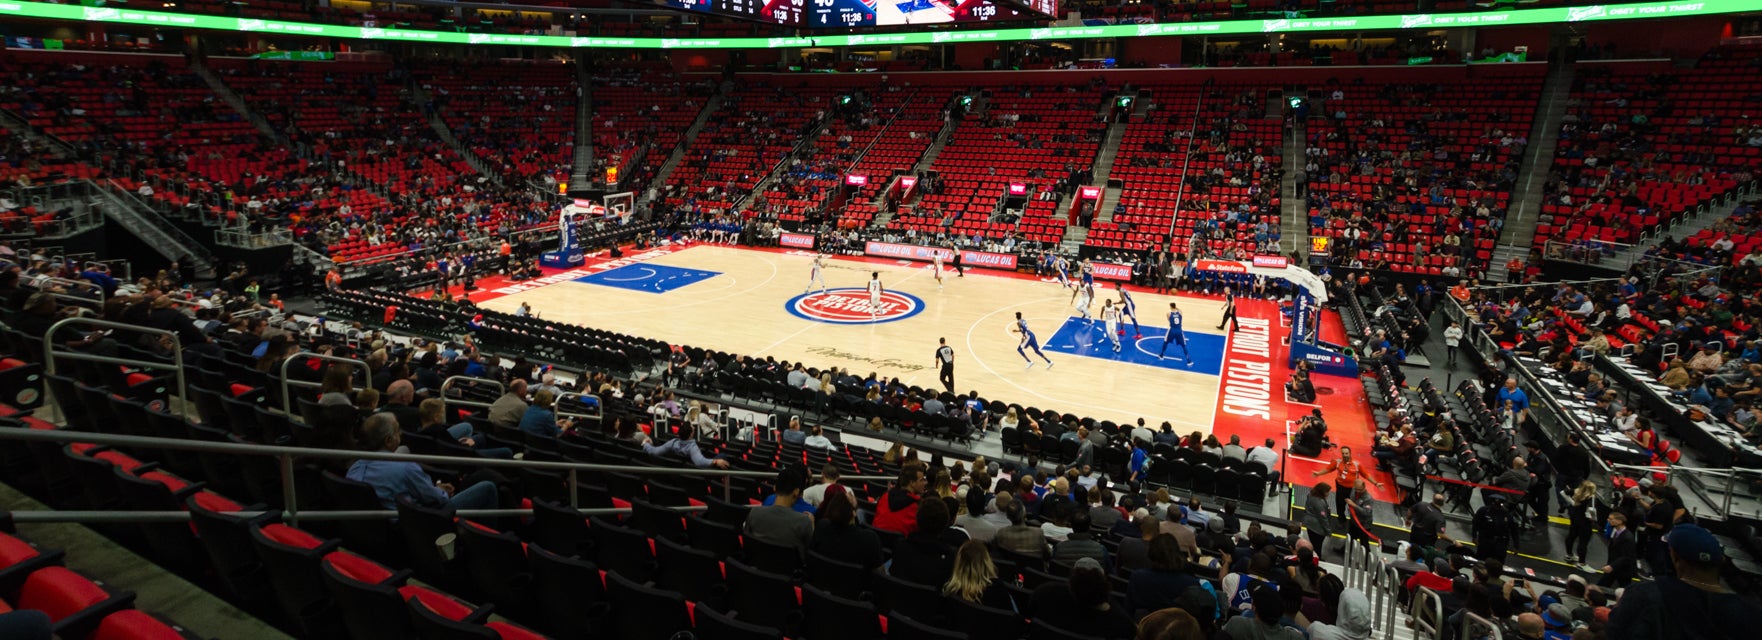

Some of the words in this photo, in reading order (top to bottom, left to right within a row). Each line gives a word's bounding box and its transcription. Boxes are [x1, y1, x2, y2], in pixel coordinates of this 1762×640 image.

[972, 6, 996, 16] 11:36
[1610, 7, 1637, 16] OBEY
[1639, 5, 1668, 14] YOUR
[1669, 3, 1705, 12] THIRST
[794, 13, 799, 23] 5
[820, 14, 827, 24] 4
[841, 13, 862, 22] 11:36
[1434, 16, 1456, 24] OBEY
[879, 245, 899, 254] LUCAS
[900, 247, 912, 256] OIL
[976, 254, 999, 265] LUCAS
[1000, 256, 1013, 265] OIL
[1095, 265, 1117, 275] LUCAS
[1118, 267, 1129, 277] OIL
[1231, 316, 1270, 358] DETROIT
[1306, 353, 1331, 362] BELFOR
[1222, 359, 1271, 421] PISTONS
